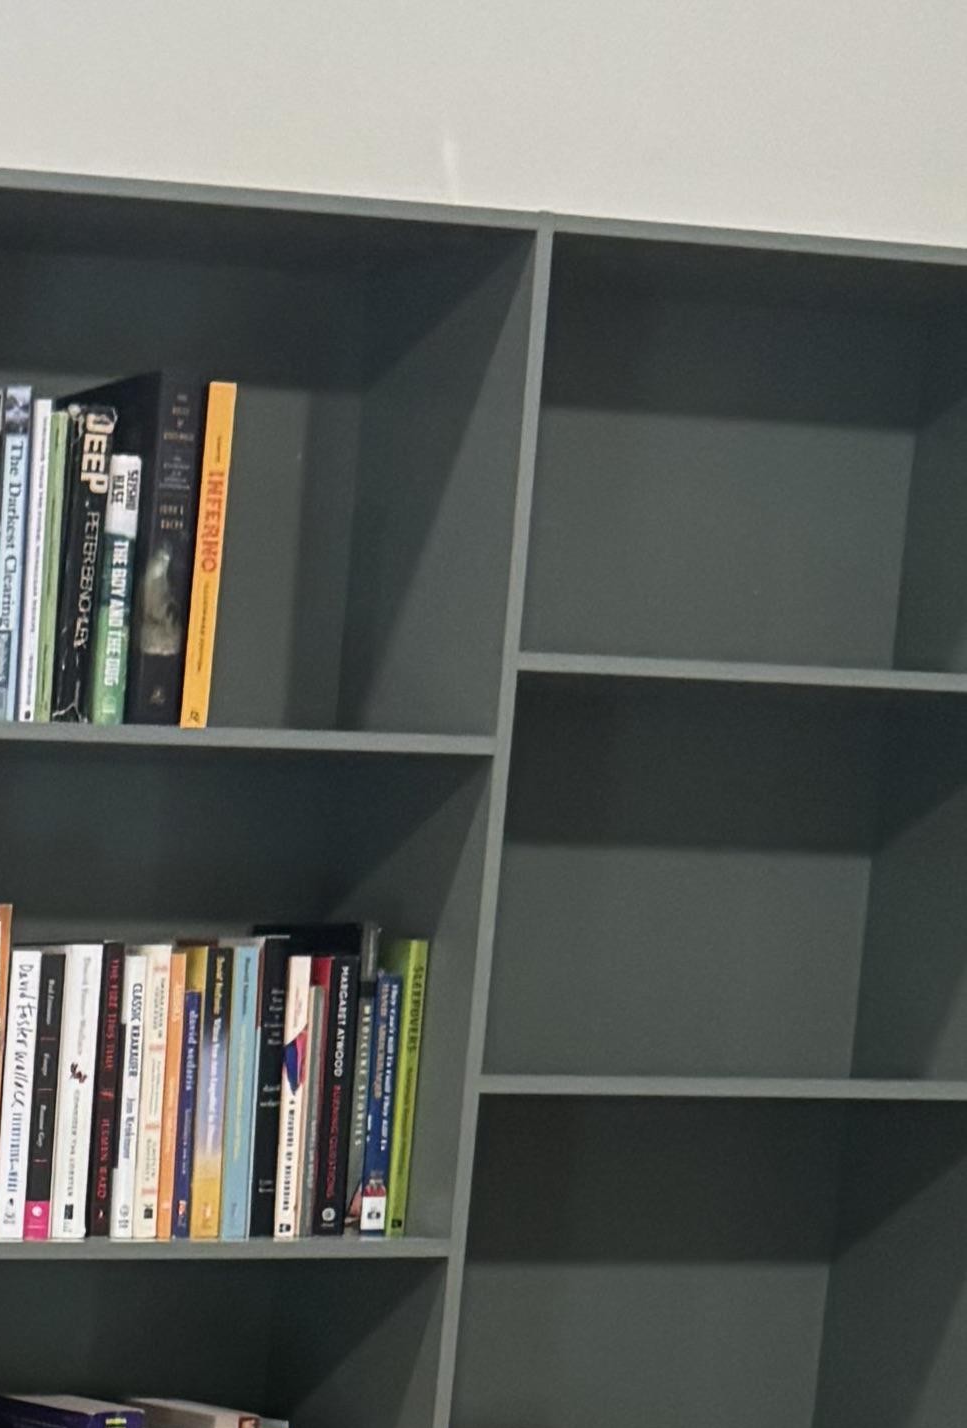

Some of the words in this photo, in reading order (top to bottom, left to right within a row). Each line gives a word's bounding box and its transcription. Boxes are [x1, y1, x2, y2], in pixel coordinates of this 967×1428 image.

[9, 442, 24, 476] The
[4, 482, 21, 549] Darkest
[203, 470, 225, 573] INFERNO
[112, 541, 129, 565] THE
[0, 554, 16, 629] Clearing
[110, 568, 127, 596] BOY
[109, 599, 125, 628] AND
[107, 631, 123, 656] THE
[104, 658, 121, 686] DOG
[336, 966, 350, 1025] MARGARET
[334, 1028, 346, 1077] ATWOOD
